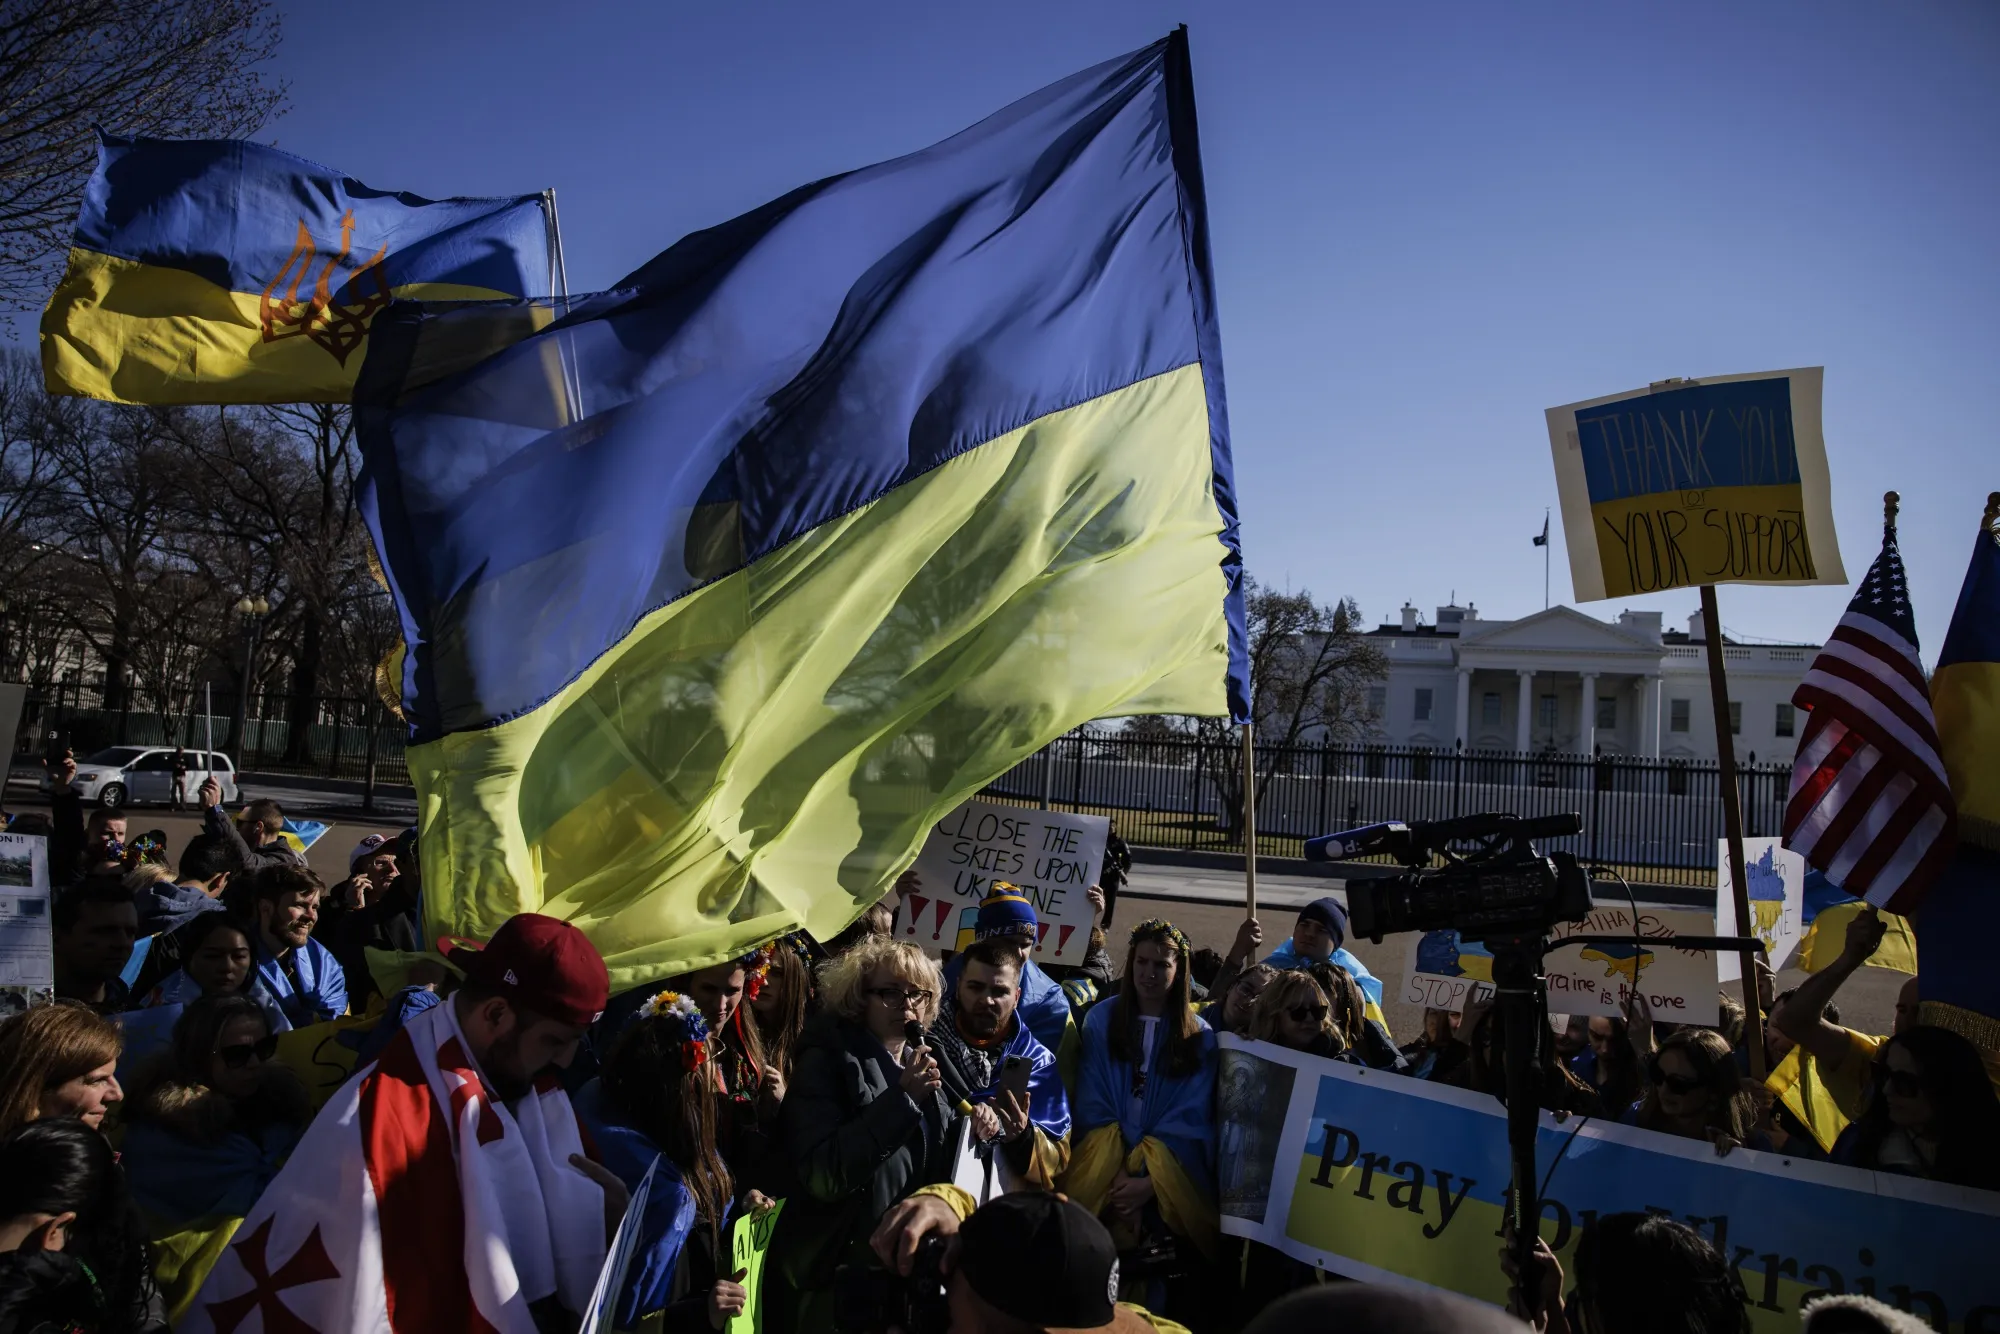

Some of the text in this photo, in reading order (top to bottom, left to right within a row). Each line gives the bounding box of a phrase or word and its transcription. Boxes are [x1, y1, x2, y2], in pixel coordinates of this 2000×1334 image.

[1577, 405, 1799, 497] THANK YOU
[1602, 508, 1812, 593] YOUR SUPPORT
[1043, 825, 1083, 854] THE
[948, 841, 1088, 884] SKIES UPON
[1408, 975, 1465, 1008] STOP
[1600, 987, 1614, 1005] is
[1650, 995, 1686, 1009] one
[1309, 1123, 1477, 1239] Pray
